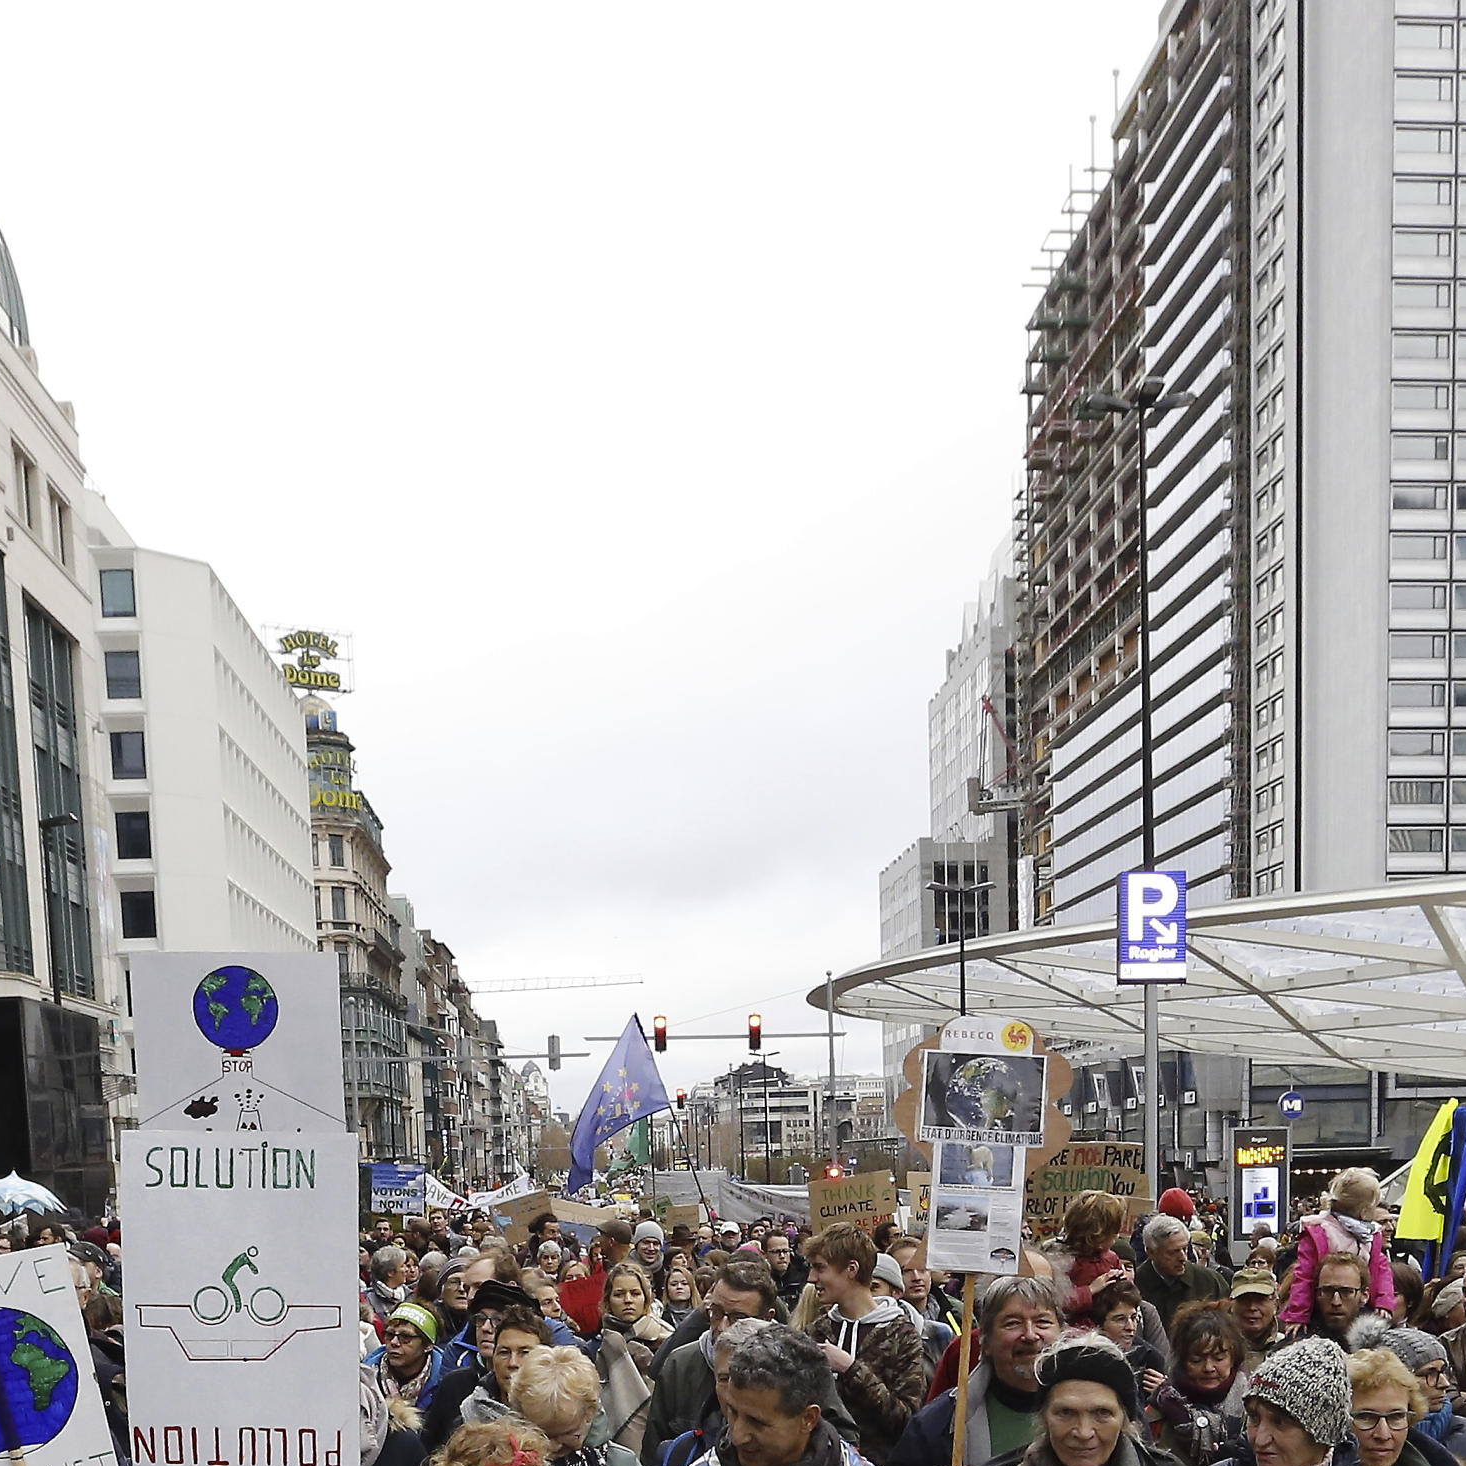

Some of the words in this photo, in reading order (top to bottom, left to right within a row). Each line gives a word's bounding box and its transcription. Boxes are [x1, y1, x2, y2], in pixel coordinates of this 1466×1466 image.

[281, 631, 338, 657] HOTEL
[302, 651, 321, 668] Le
[283, 664, 340, 688] Dome
[1128, 873, 1179, 941] P
[1129, 945, 1178, 962] Rogier
[944, 1029, 995, 1041] REBECQ
[222, 1060, 253, 1073] STOP
[945, 1129, 994, 1143] D'URGENCE
[994, 1131, 1044, 1145] CLIMATIQUE
[145, 1141, 316, 1190] SOLUTION
[372, 1186, 418, 1197] VOTONS
[427, 1185, 447, 1203] AVE
[821, 1184, 876, 1201] THINK
[379, 1199, 403, 1209] NON
[1044, 1198, 1058, 1215] OF
